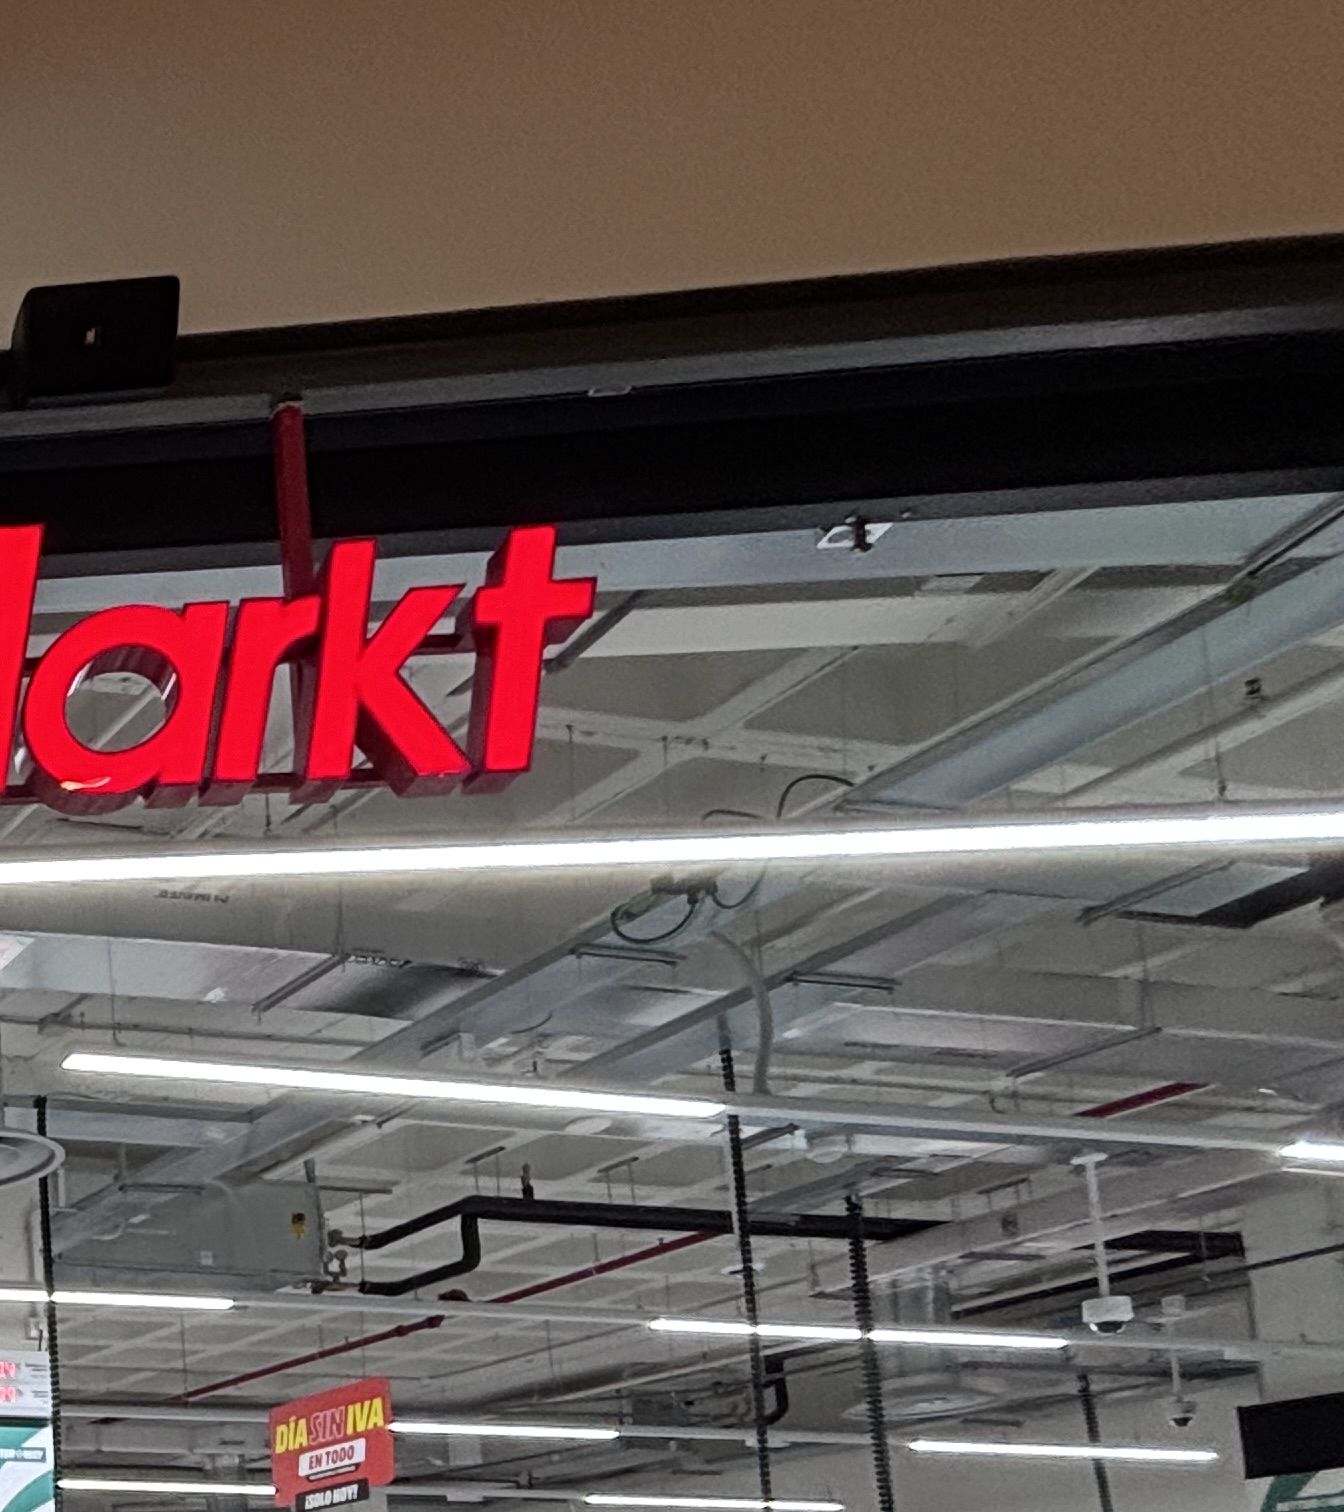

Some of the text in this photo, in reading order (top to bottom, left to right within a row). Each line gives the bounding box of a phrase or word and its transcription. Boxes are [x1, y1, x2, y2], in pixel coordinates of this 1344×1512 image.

[275, 1396, 385, 1454] DÍA SIN IVA
[308, 1445, 355, 1471] EN TODO
